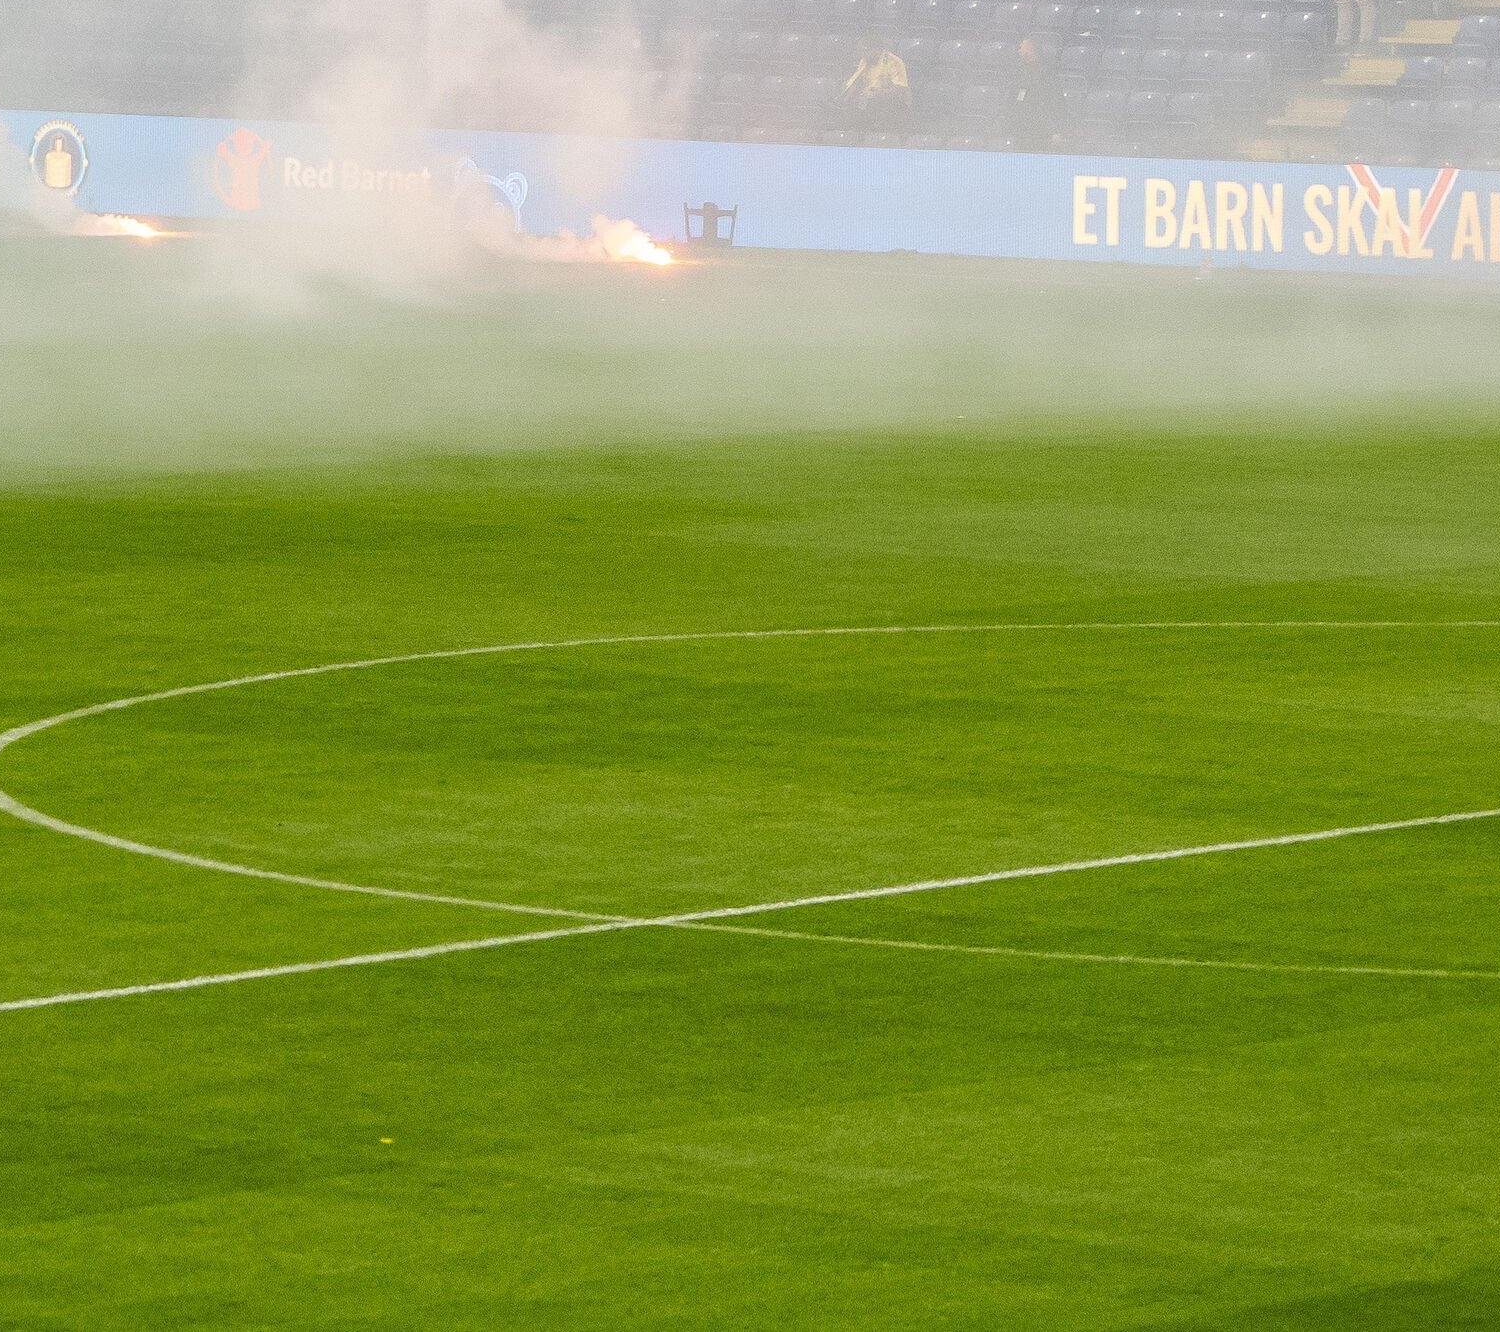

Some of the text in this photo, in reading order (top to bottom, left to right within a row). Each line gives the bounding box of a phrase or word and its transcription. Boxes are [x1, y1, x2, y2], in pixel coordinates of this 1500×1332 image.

[1073, 175, 1127, 247] ET
[1144, 178, 1285, 254] BARN
[1303, 184, 1434, 259] SKAL
